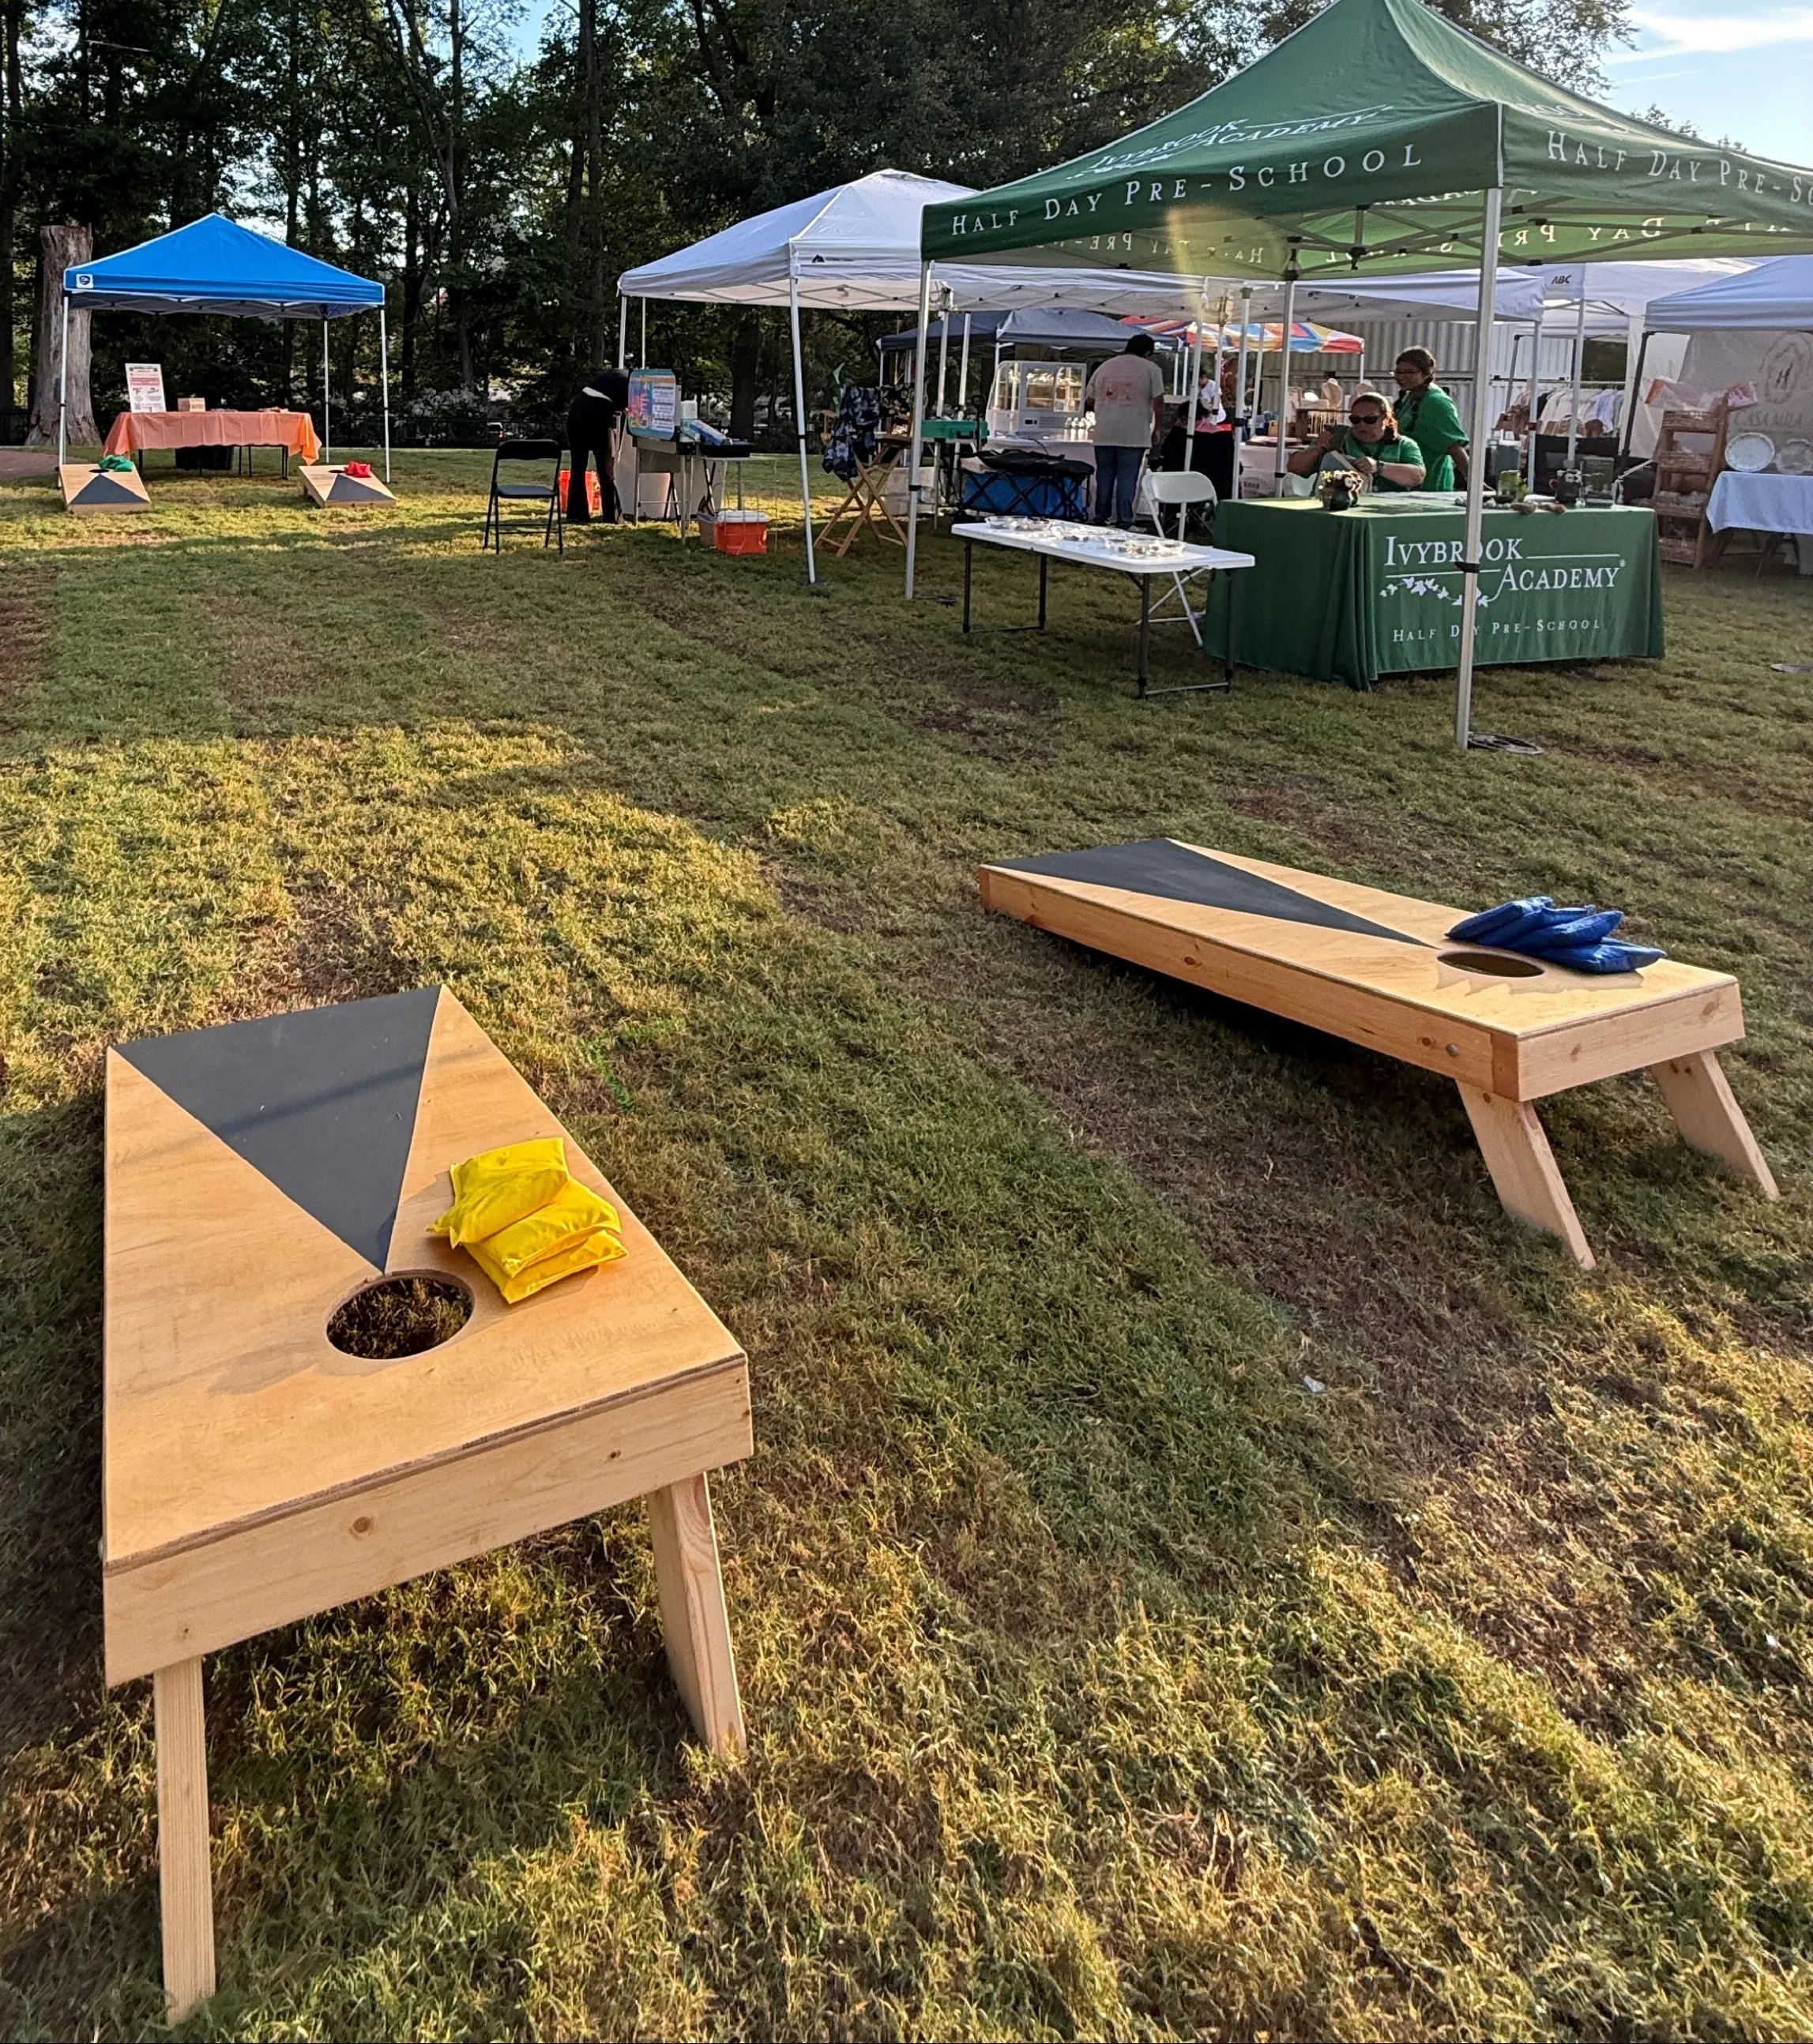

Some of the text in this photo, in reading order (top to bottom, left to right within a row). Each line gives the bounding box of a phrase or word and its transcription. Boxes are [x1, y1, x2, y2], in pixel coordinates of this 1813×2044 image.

[1201, 112, 1379, 147] ACADEMY
[1548, 130, 1627, 171] HALF
[1648, 149, 1701, 182] DAY
[951, 209, 1018, 235] HALF
[1044, 193, 1102, 220] DAY
[1124, 144, 1421, 205] PRE-SCHOOL
[1384, 536, 1522, 565] IVYBROK
[1500, 563, 1620, 591] ACADEMY
[1393, 619, 1600, 642] HALF DY PRE-SCHOOL
